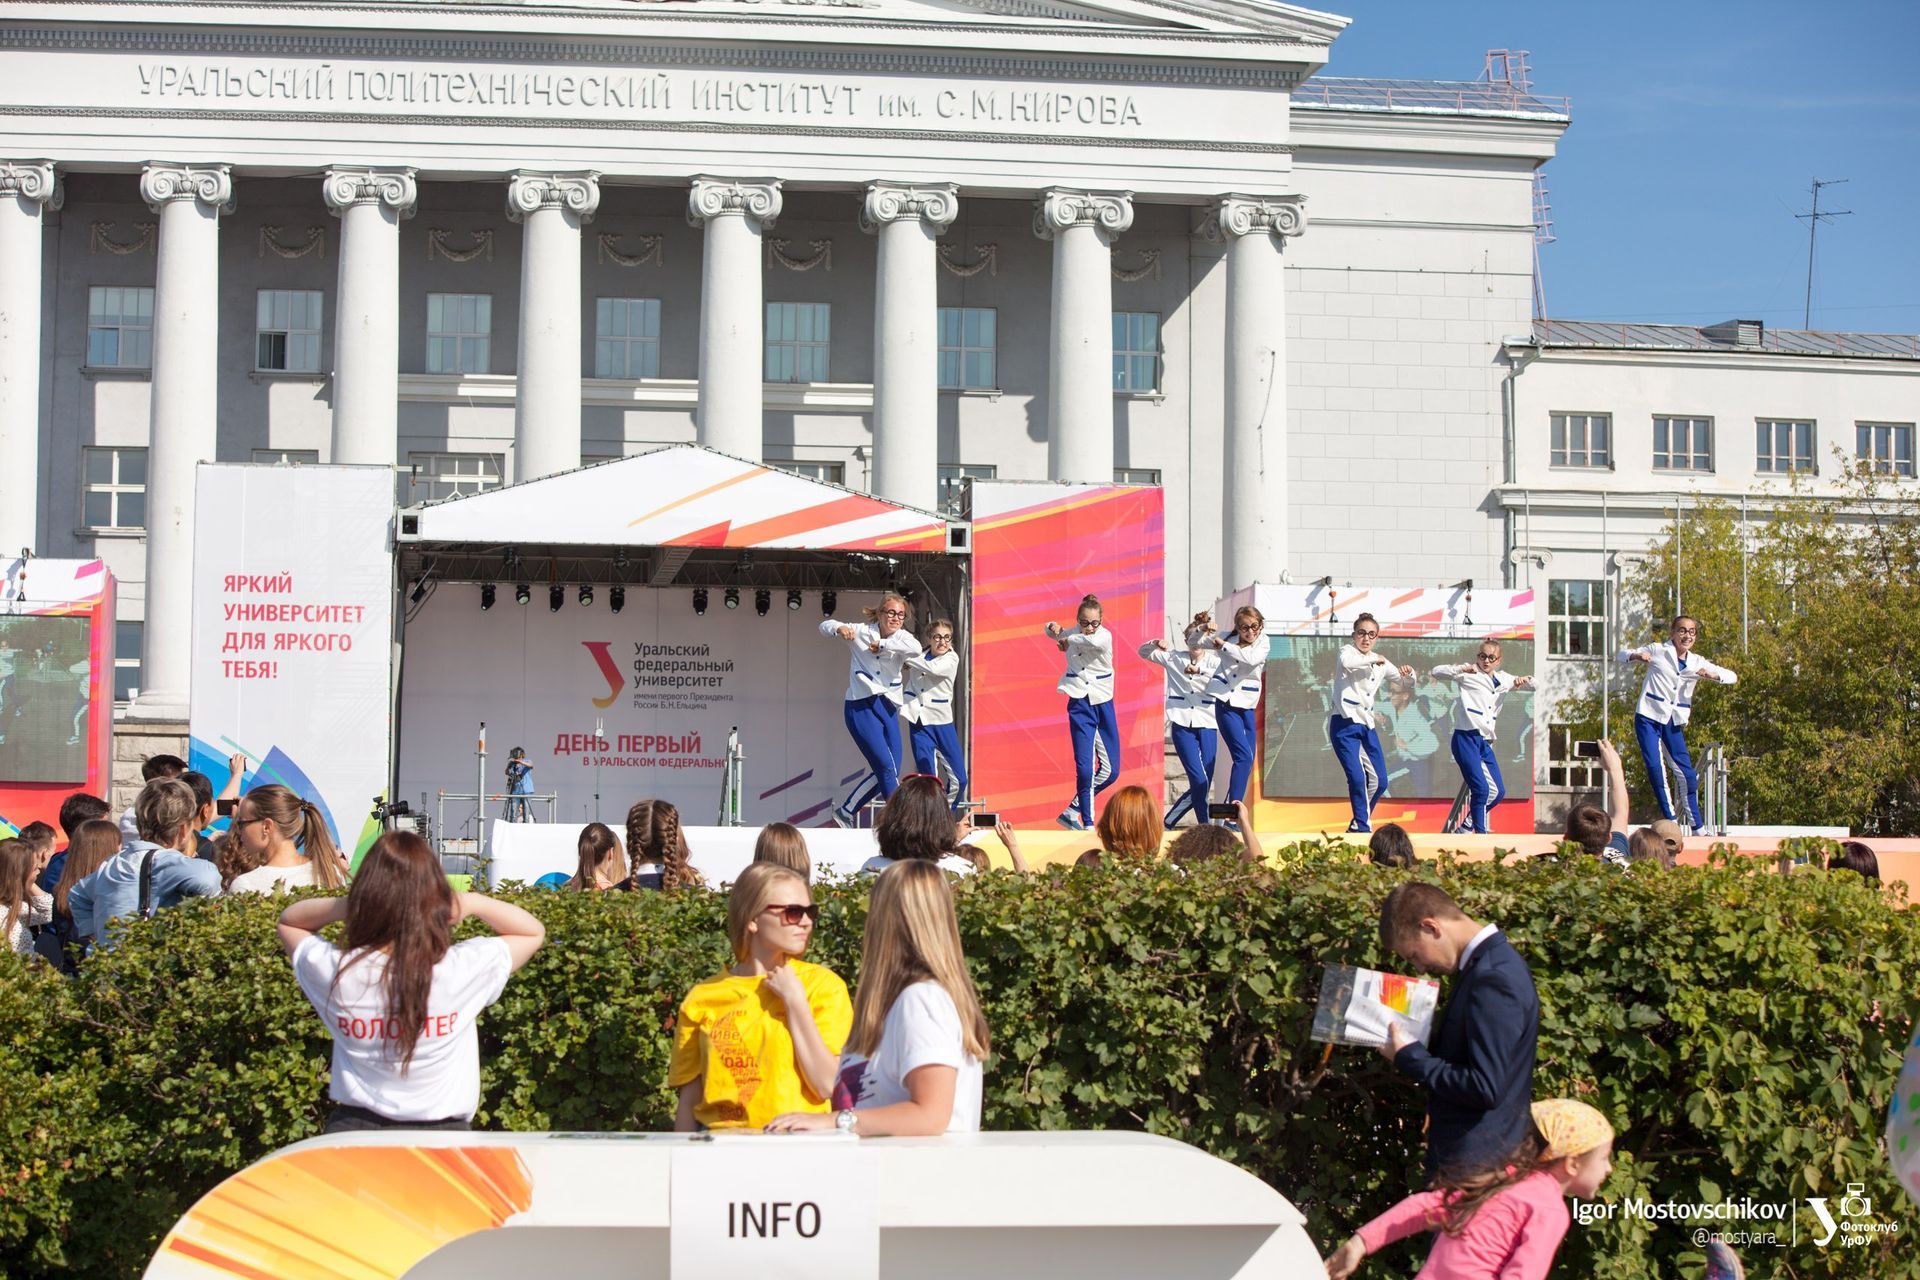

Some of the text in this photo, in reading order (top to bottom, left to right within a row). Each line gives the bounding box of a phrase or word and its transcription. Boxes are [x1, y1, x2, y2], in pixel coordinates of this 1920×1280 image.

[138, 64, 334, 100] УРАЛЬСКИЙ
[692, 79, 861, 116] ИНСТИТУТ
[223, 570, 293, 593] ЯРКИЙ
[223, 603, 366, 624] УНИВЕРСИТЕТ
[222, 632, 353, 654] ДЛЯ ЯРКОГО
[634, 641, 710, 658] Уральский
[222, 661, 278, 679] ТЕБЯ!
[633, 659, 734, 674] федеральный
[634, 675, 724, 689] университет
[633, 701, 659, 709] России
[657, 693, 688, 702] первого
[689, 692, 734, 702] Президента
[554, 731, 702, 755] ДЕНЬ ПЕРВЫЙ
[582, 756, 590, 766] В
[658, 757, 726, 769] ФЕДЕРАЛЬНО
[336, 1012, 458, 1040] ВОЛОТЕР
[728, 1201, 822, 1239] INFO
